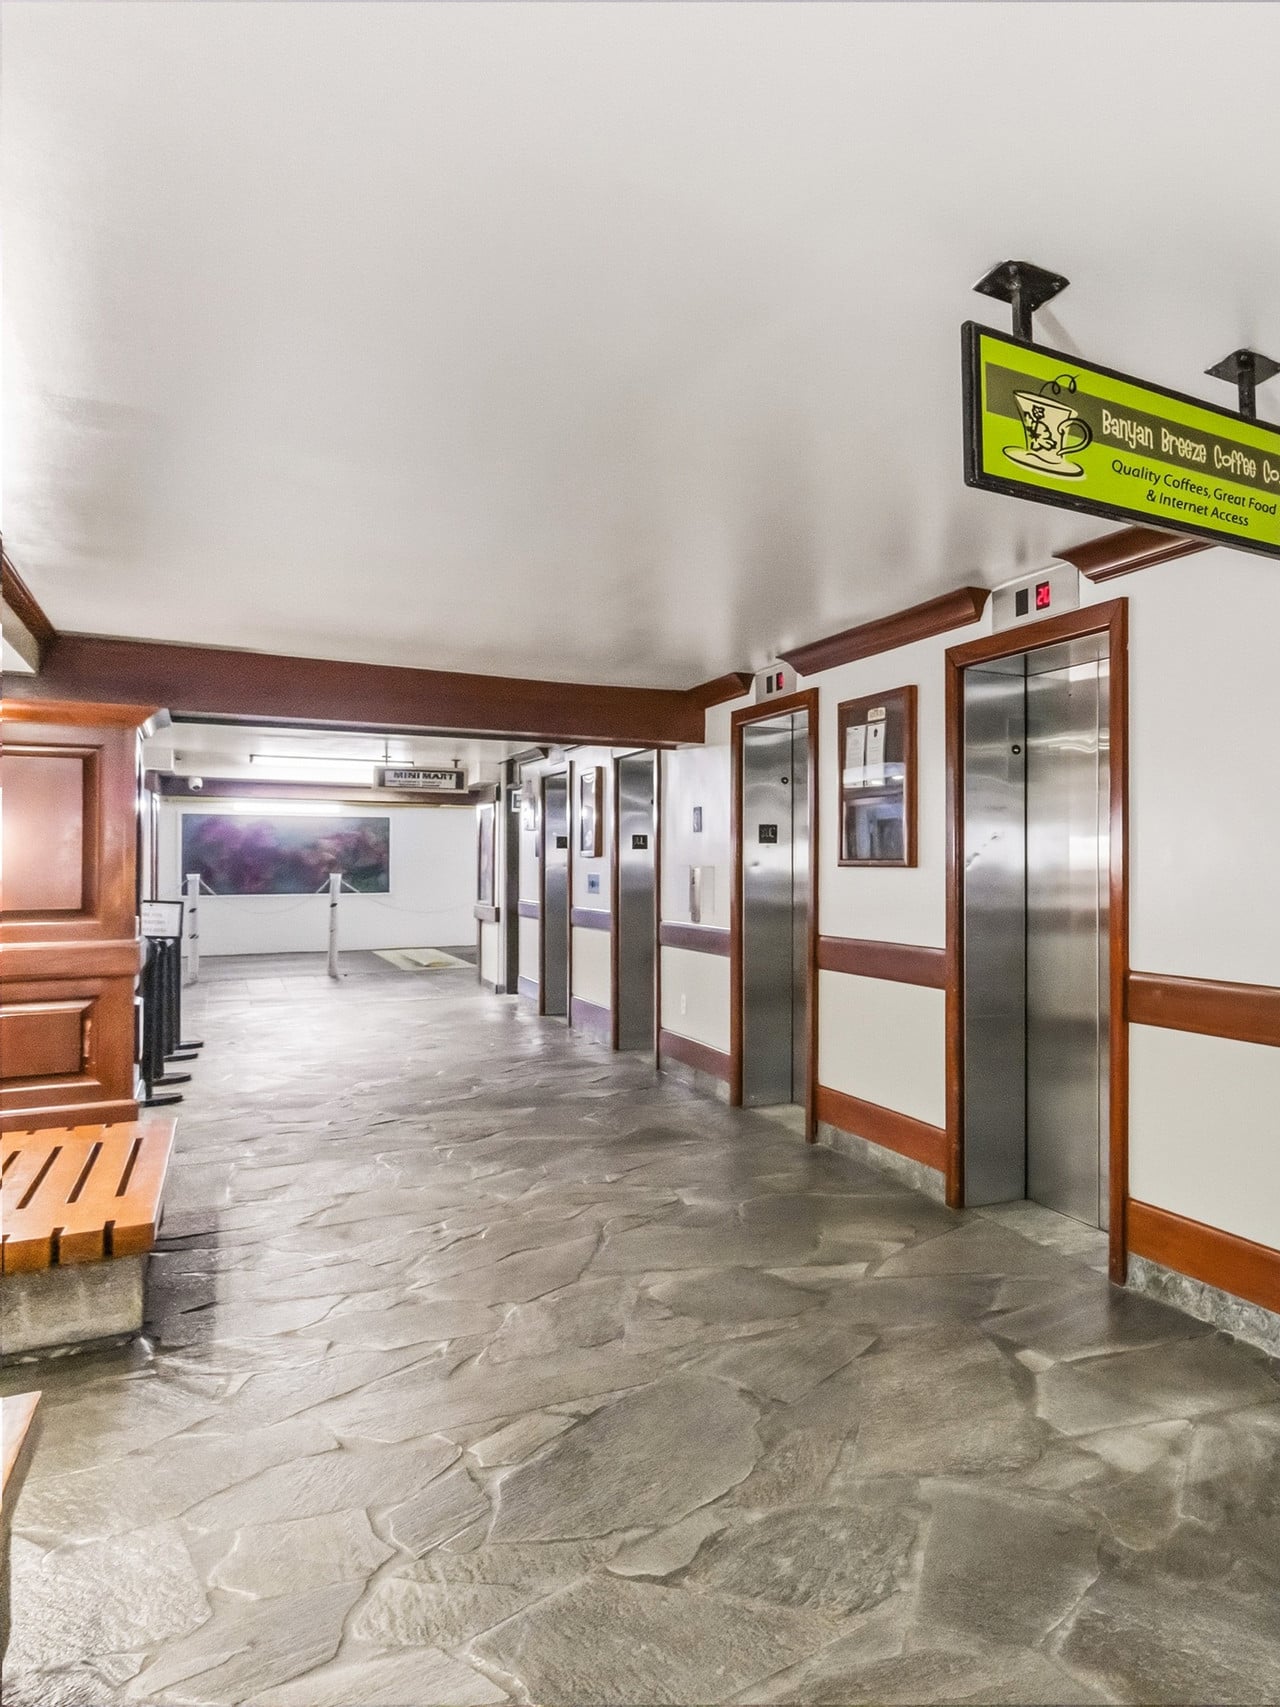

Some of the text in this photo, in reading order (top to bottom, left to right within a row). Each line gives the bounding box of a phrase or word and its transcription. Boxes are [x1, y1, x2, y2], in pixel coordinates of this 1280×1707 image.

[1102, 408, 1153, 449] Banyan
[1162, 427, 1207, 463] Breeze
[1214, 446, 1256, 477] Coffee
[1111, 459, 1277, 516] Quality Coffees, Great Food
[1146, 489, 1249, 527] & Internet Access
[393, 771, 454, 781] MINI MART
